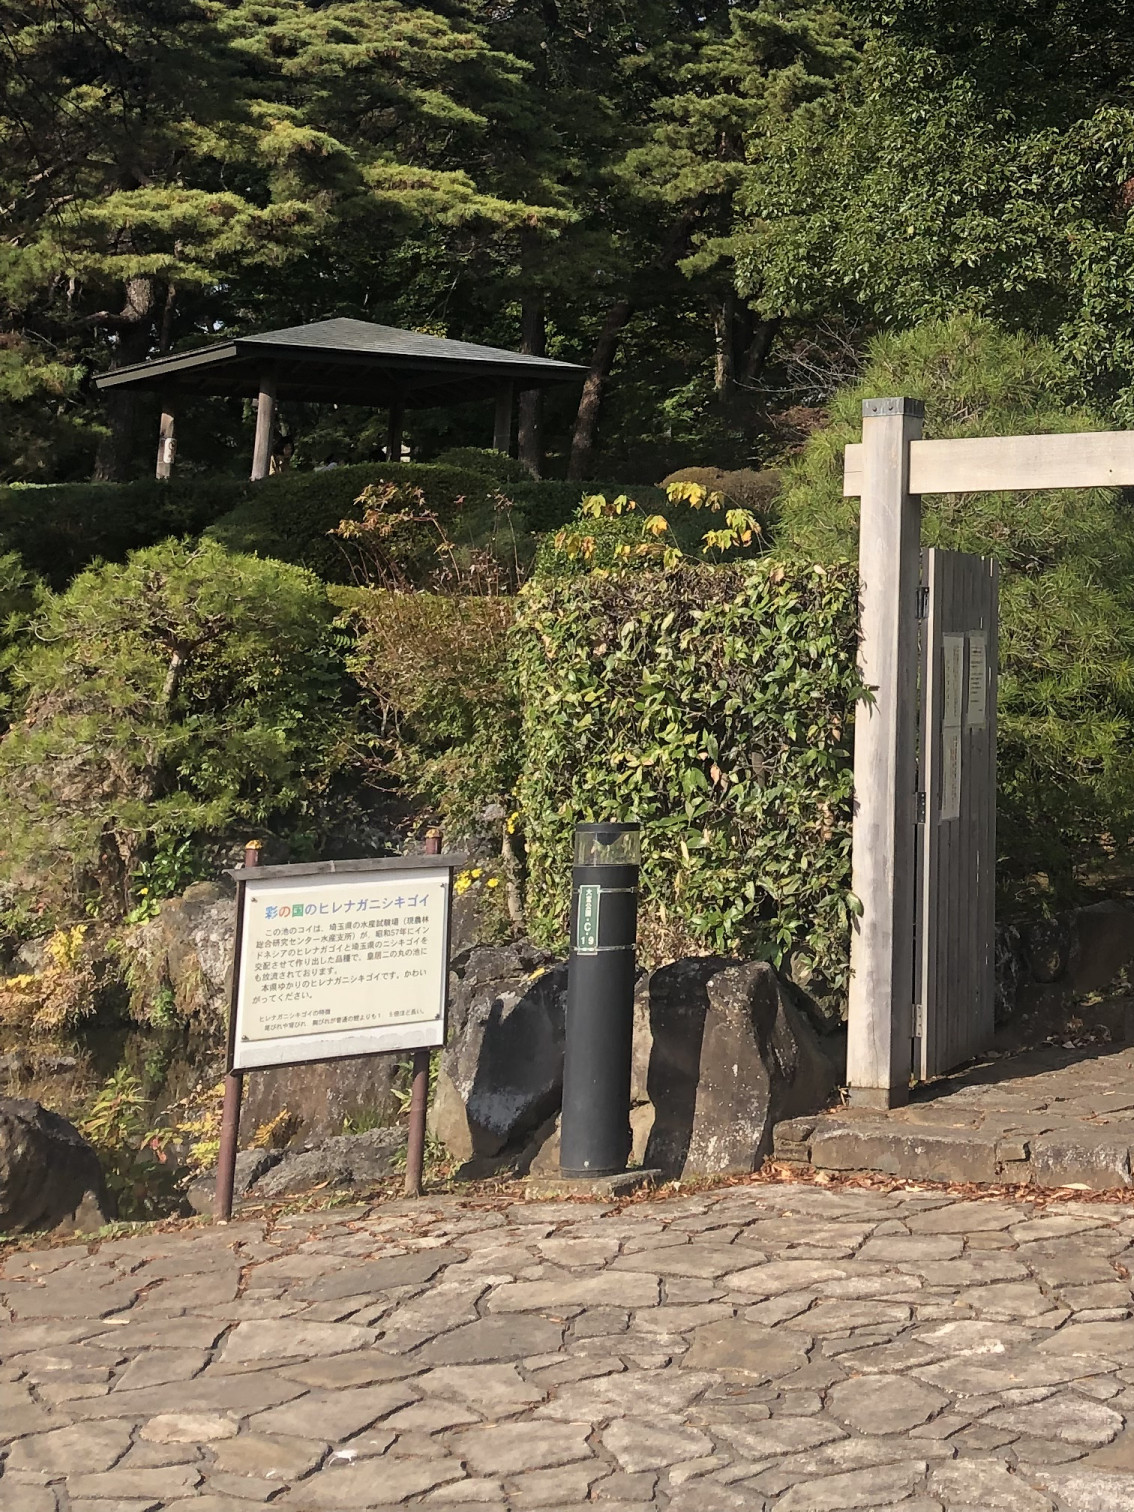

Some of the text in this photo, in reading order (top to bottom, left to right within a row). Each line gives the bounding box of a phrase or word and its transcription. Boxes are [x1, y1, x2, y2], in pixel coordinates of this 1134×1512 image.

[264, 893, 430, 920] 彩の国のヒレナガニシキゴイ
[251, 990, 314, 1005] がってください。
